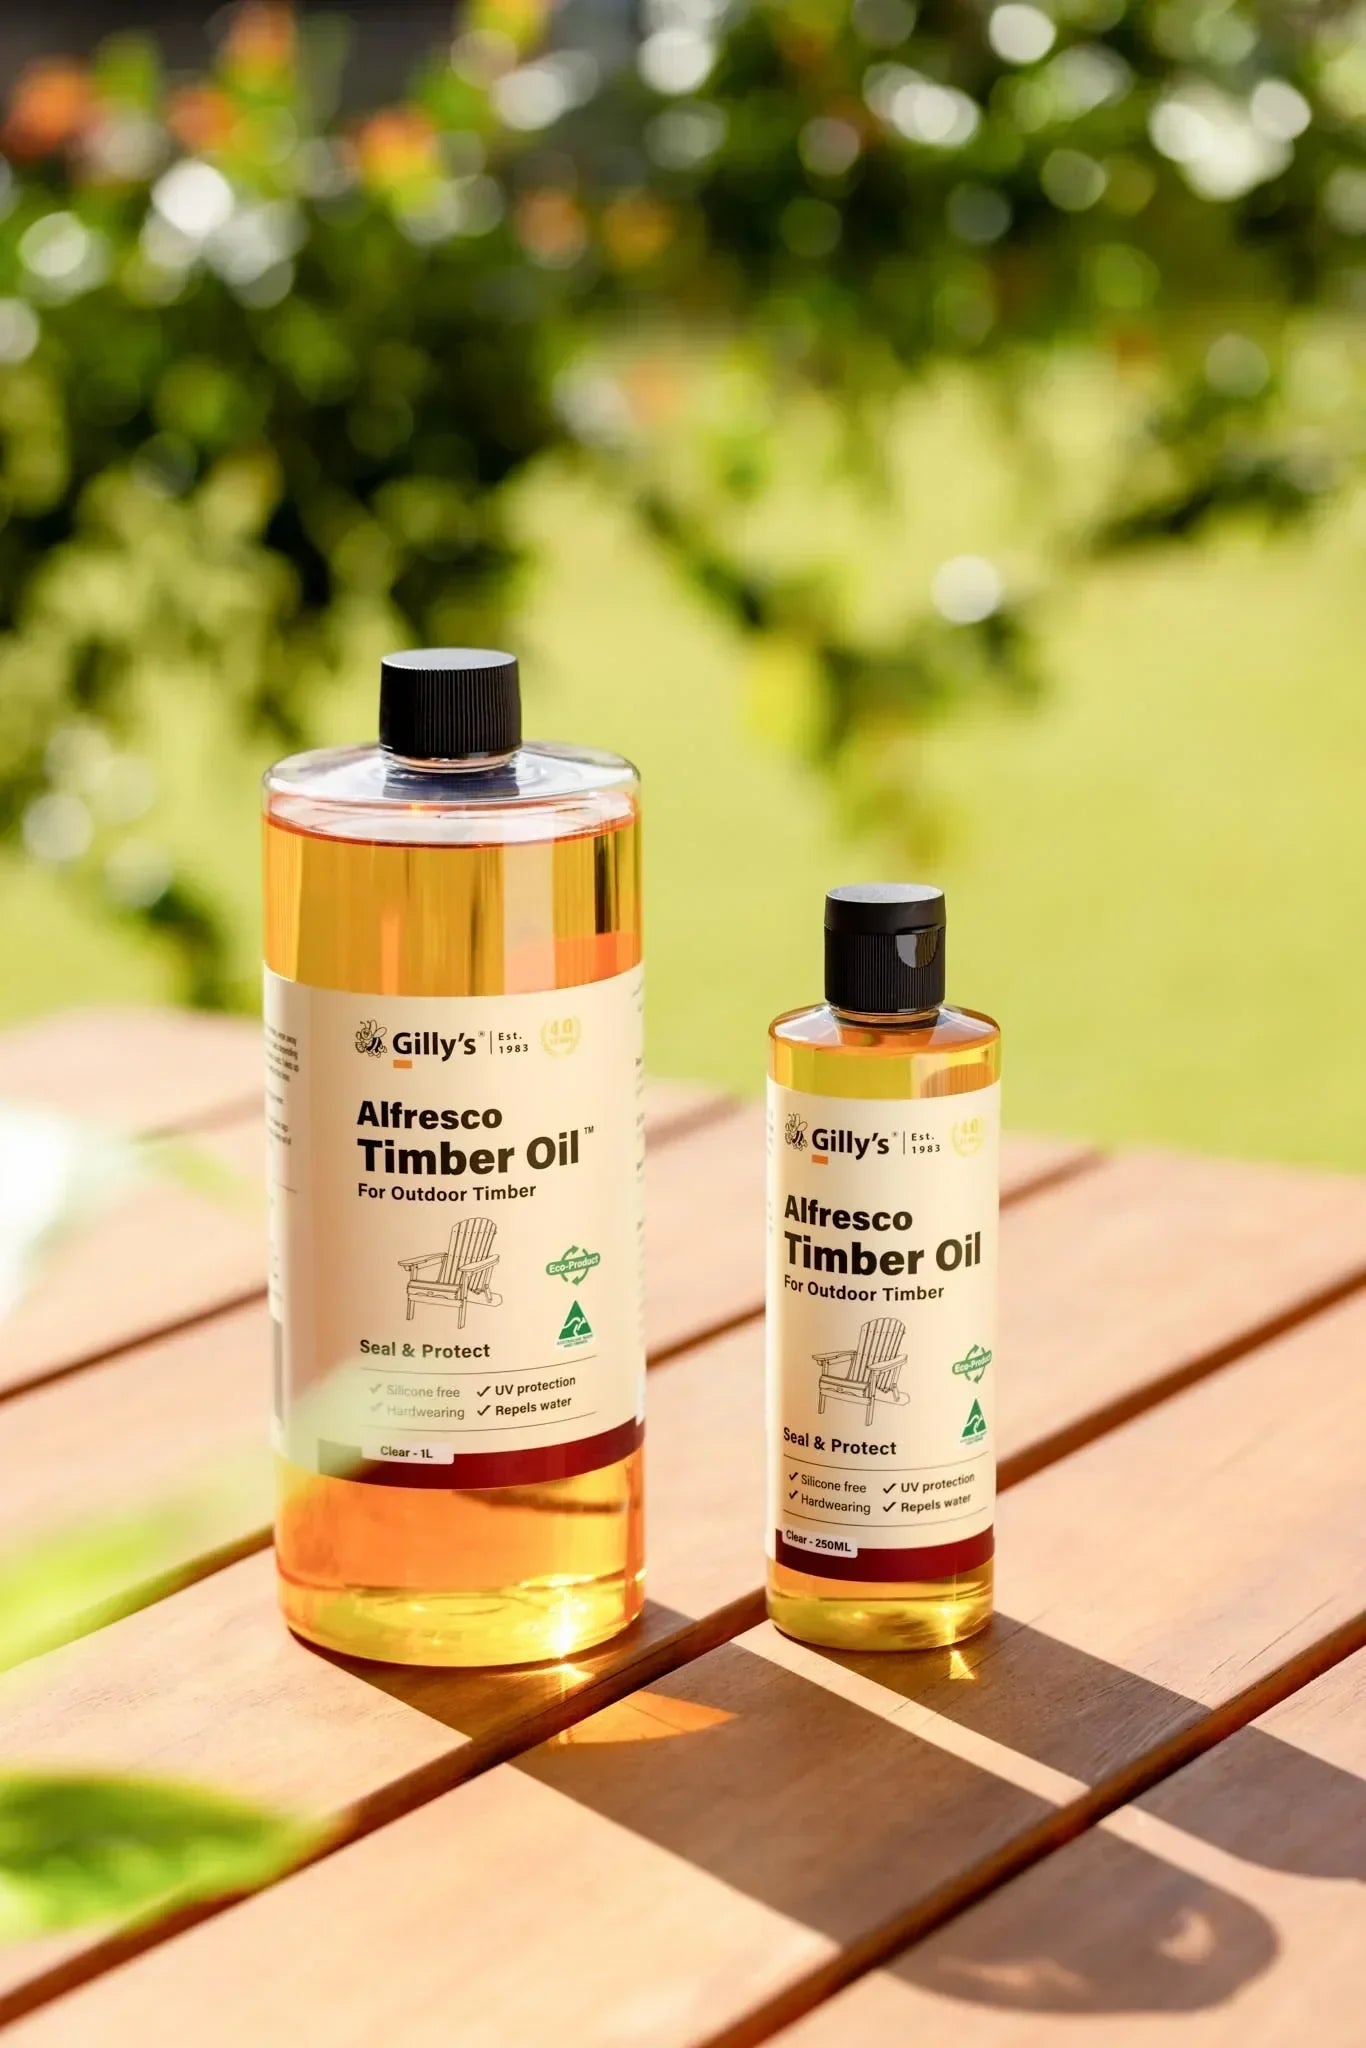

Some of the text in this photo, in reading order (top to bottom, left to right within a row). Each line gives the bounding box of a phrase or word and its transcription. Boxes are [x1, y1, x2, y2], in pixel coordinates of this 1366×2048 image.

[498, 1032, 523, 1041] Est.
[499, 1043, 529, 1054] 1983
[356, 1100, 503, 1130] Alfresco
[911, 1132, 936, 1142] Est.
[357, 1138, 515, 1176] Timber
[526, 1129, 580, 1171] Oil
[911, 1144, 942, 1155] 1983
[357, 1183, 537, 1202] For Outdoor Timber
[784, 1194, 914, 1231] Alfresco
[549, 1255, 599, 1273] Eco-Product
[784, 1230, 982, 1276] Timber Oil
[784, 1274, 945, 1301] For Outdoor Timber
[360, 1339, 491, 1359] Seal & Protect
[386, 1384, 461, 1399] Silicone free
[495, 1374, 577, 1397] UV protection
[386, 1404, 466, 1421] Hardwearing
[495, 1396, 573, 1418] Repels water
[783, 1426, 897, 1456] Seal & Protect
[380, 1445, 411, 1459] Clear
[421, 1449, 434, 1460] 1L
[801, 1474, 867, 1493] Silicone free
[901, 1472, 975, 1494] UV protection
[801, 1493, 872, 1516] Hardwearing
[901, 1493, 972, 1515] Repels water
[786, 1529, 808, 1546] Clear
[815, 1538, 852, 1552] 250ML
